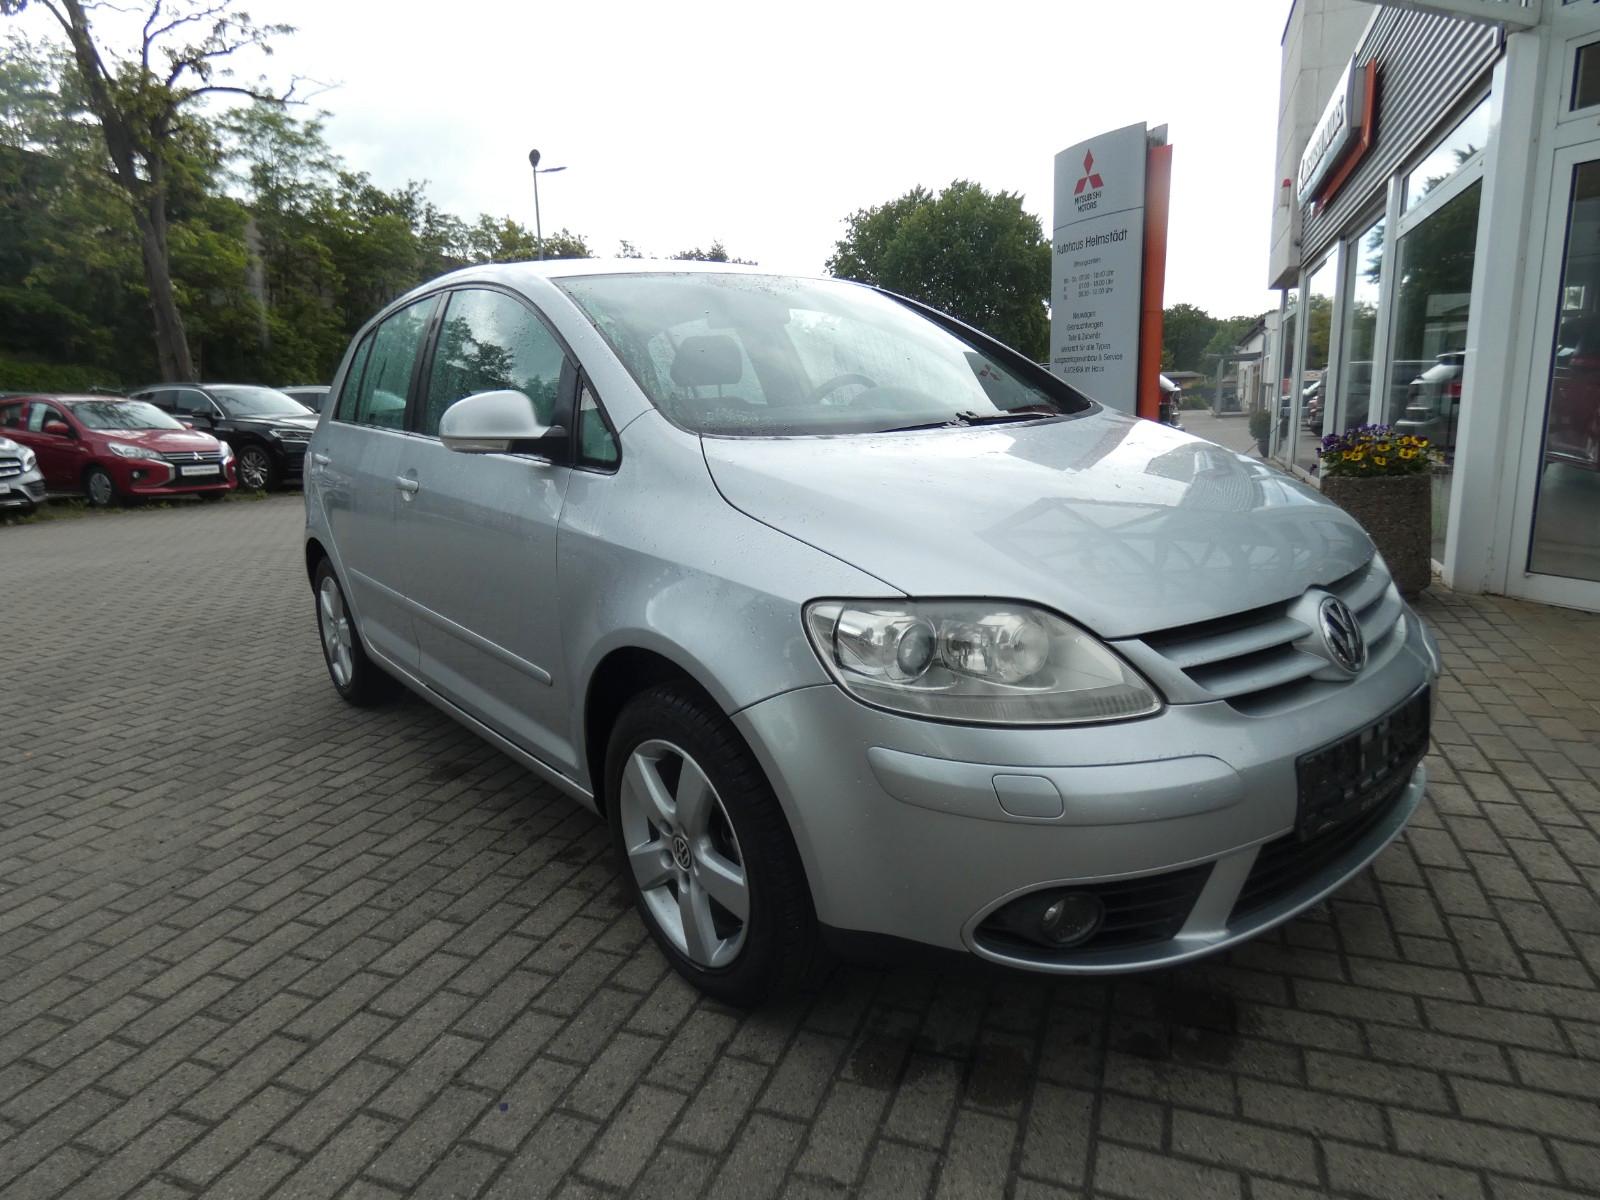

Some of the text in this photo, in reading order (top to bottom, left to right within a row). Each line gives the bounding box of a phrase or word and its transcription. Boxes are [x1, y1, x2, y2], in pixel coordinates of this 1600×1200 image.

[1078, 200, 1098, 213] MOTORS
[1056, 229, 1128, 256] Autohaus Helmstädt
